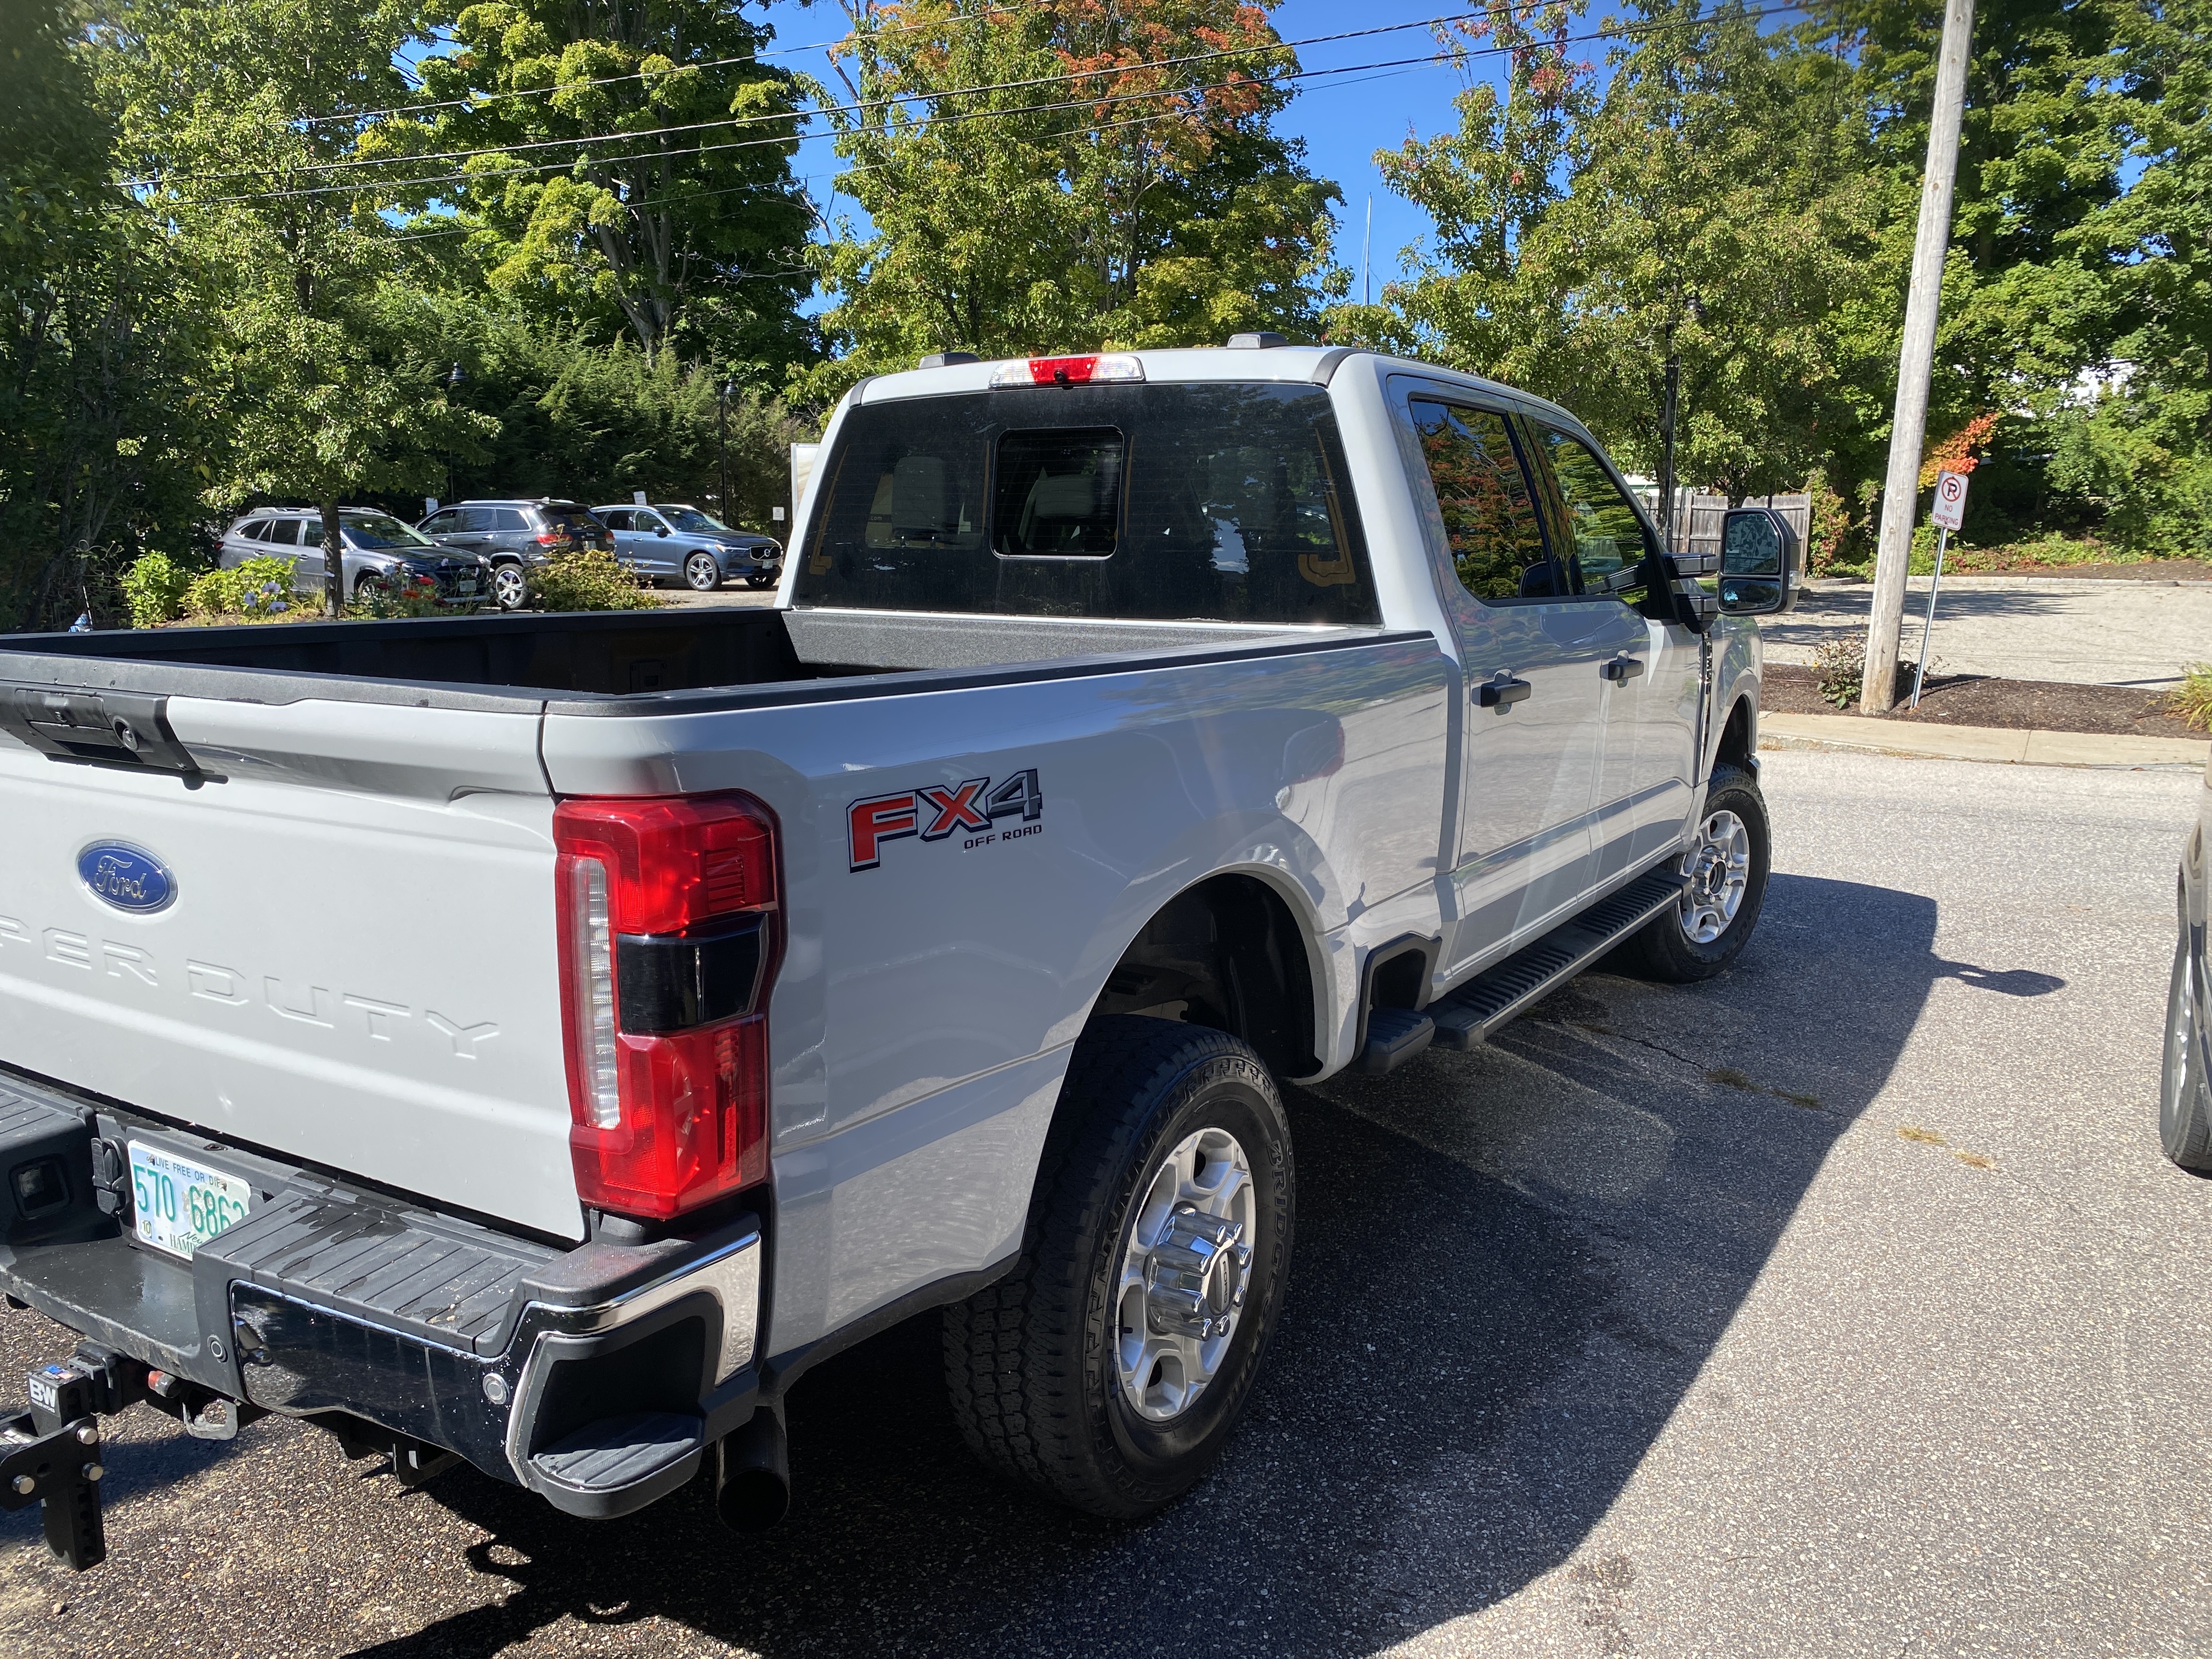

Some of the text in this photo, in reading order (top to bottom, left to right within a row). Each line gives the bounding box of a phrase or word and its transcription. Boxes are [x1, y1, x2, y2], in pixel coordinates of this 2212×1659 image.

[1934, 513, 1959, 525] PARKING
[1944, 504, 1953, 512] NO
[846, 768, 1043, 874] FX4
[964, 825, 1042, 849] OFF ROAD
[94, 854, 147, 900] Ford
[187, 958, 501, 1060] DUTY
[155, 1156, 170, 1170] LIVE
[172, 1162, 191, 1178] FREE
[194, 1171, 205, 1183] OR
[133, 1164, 176, 1222] 570
